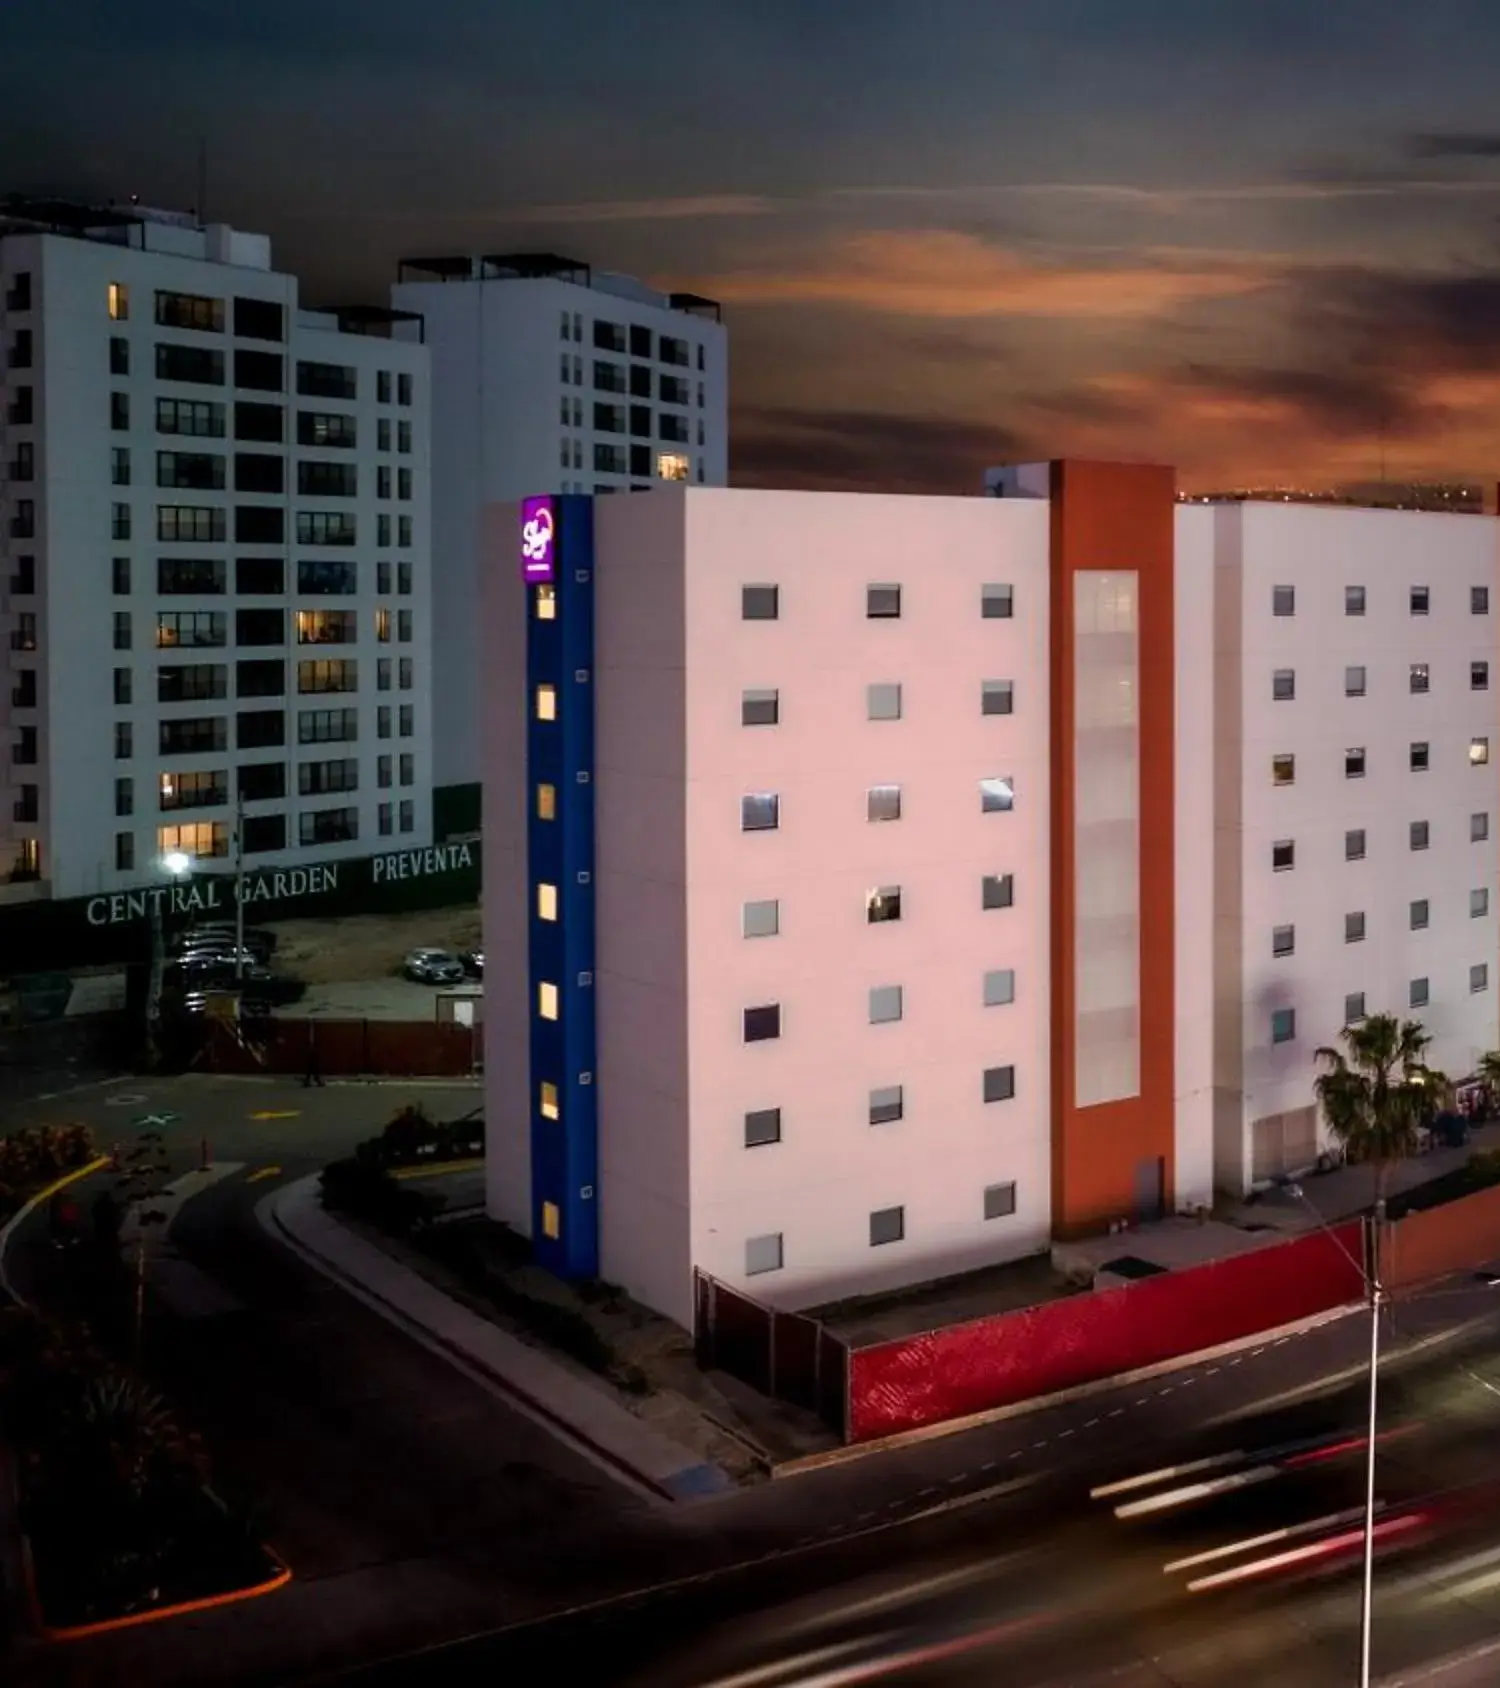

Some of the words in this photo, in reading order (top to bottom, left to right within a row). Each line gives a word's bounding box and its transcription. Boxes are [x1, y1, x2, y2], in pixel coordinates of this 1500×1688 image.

[87, 881, 221, 926] CENTRAL
[234, 863, 338, 904] GARDEN
[373, 844, 473, 883] PREVENTA
